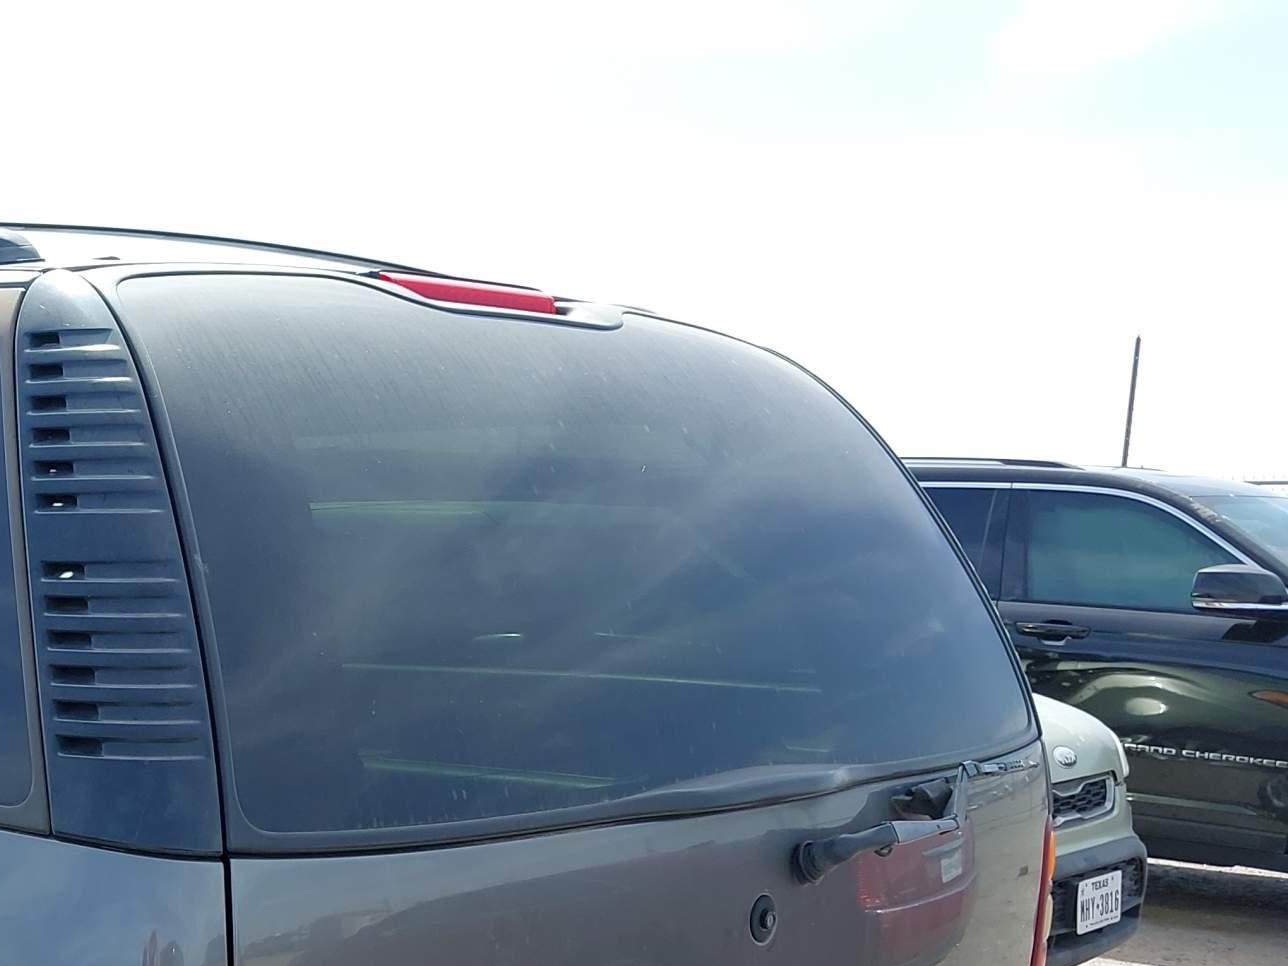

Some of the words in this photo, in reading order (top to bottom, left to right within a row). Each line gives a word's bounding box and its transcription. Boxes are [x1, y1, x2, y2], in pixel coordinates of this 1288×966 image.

[1122, 743, 1177, 756] RAND
[1182, 749, 1288, 769] CHEROKEE
[1091, 878, 1109, 891] TEXAS
